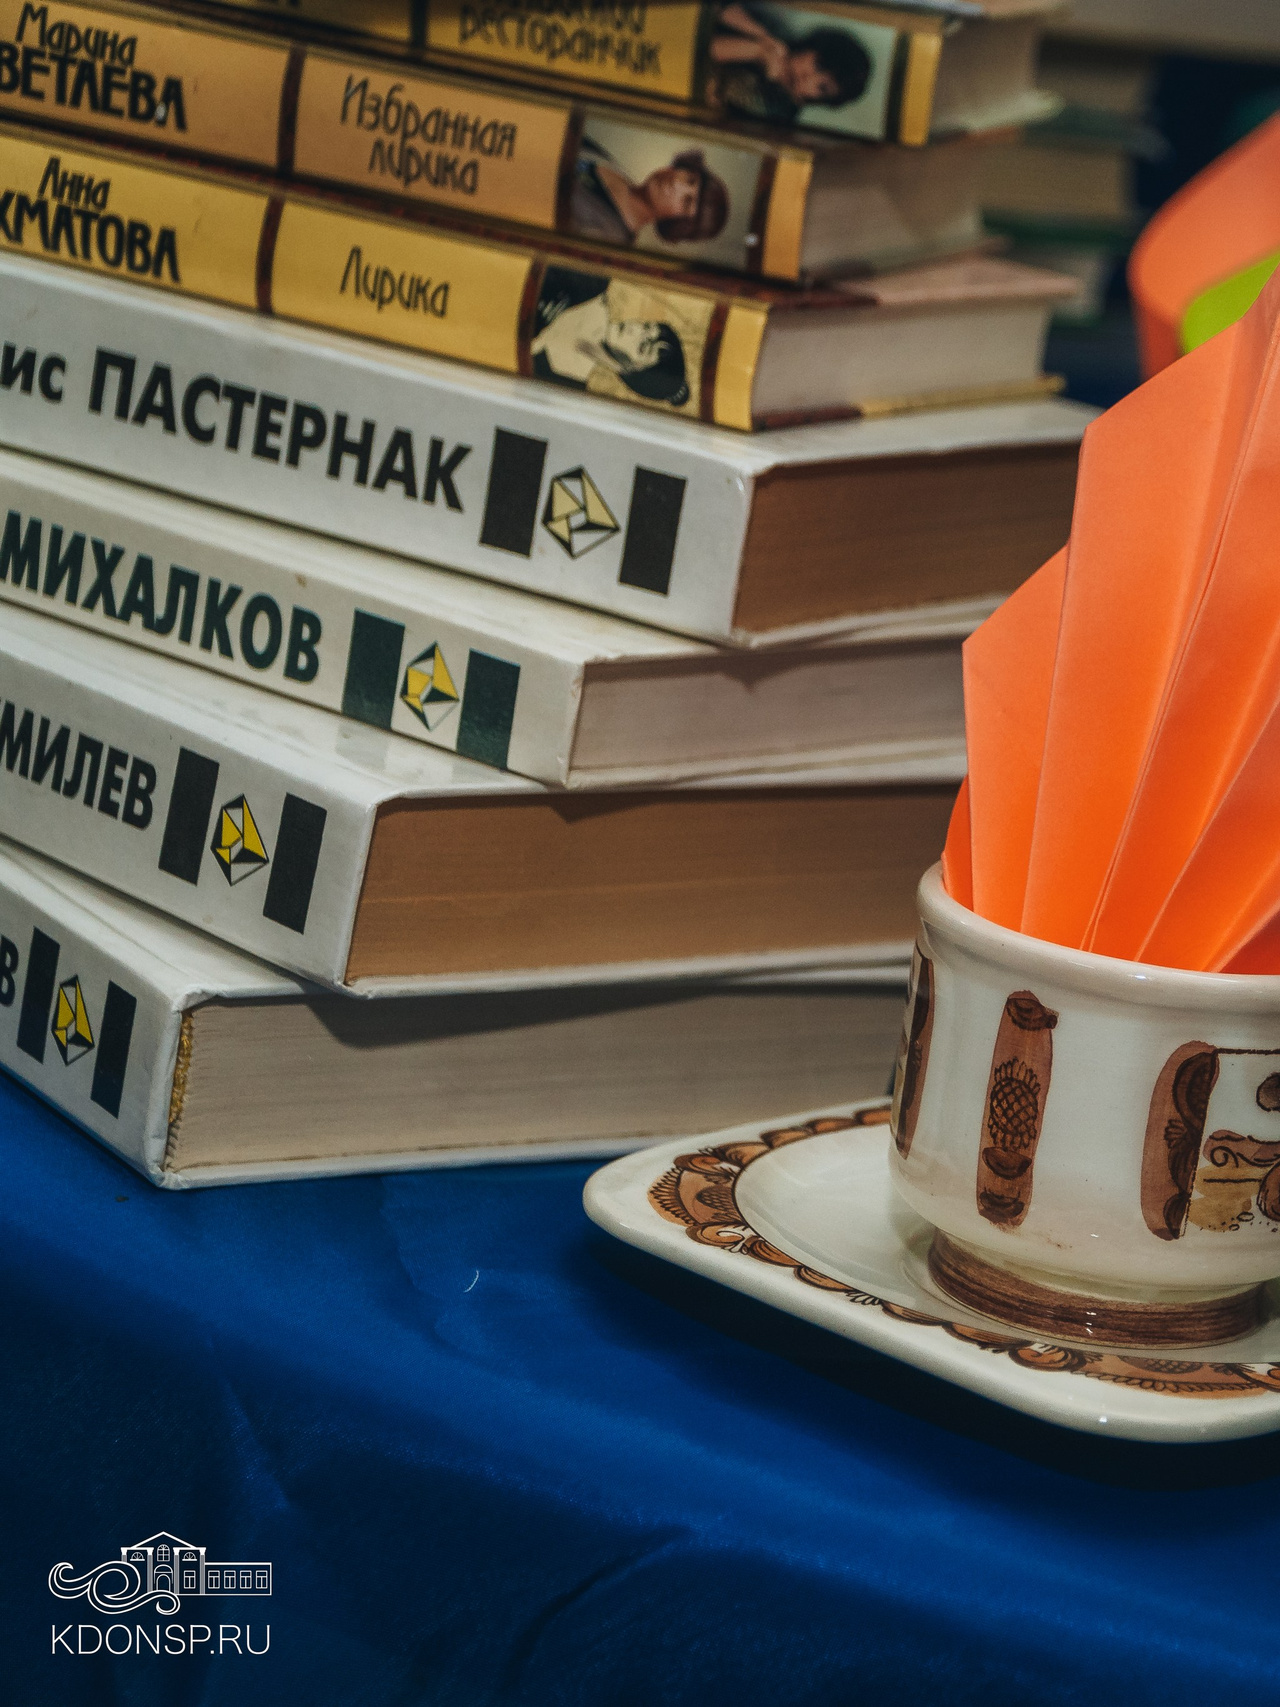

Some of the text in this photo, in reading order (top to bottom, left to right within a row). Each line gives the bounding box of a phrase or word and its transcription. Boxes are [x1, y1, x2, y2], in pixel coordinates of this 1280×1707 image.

[15, 2, 138, 68] Марина
[340, 73, 518, 161] Избранная
[38, 157, 112, 211] Анна
[368, 139, 481, 197] лирика
[339, 246, 451, 319] Лирика
[1, 340, 472, 515] ис ПАСТЕРНАК
[0, 509, 322, 685] МИХАЛКОВ
[0, 700, 158, 831] МИЛЕВ
